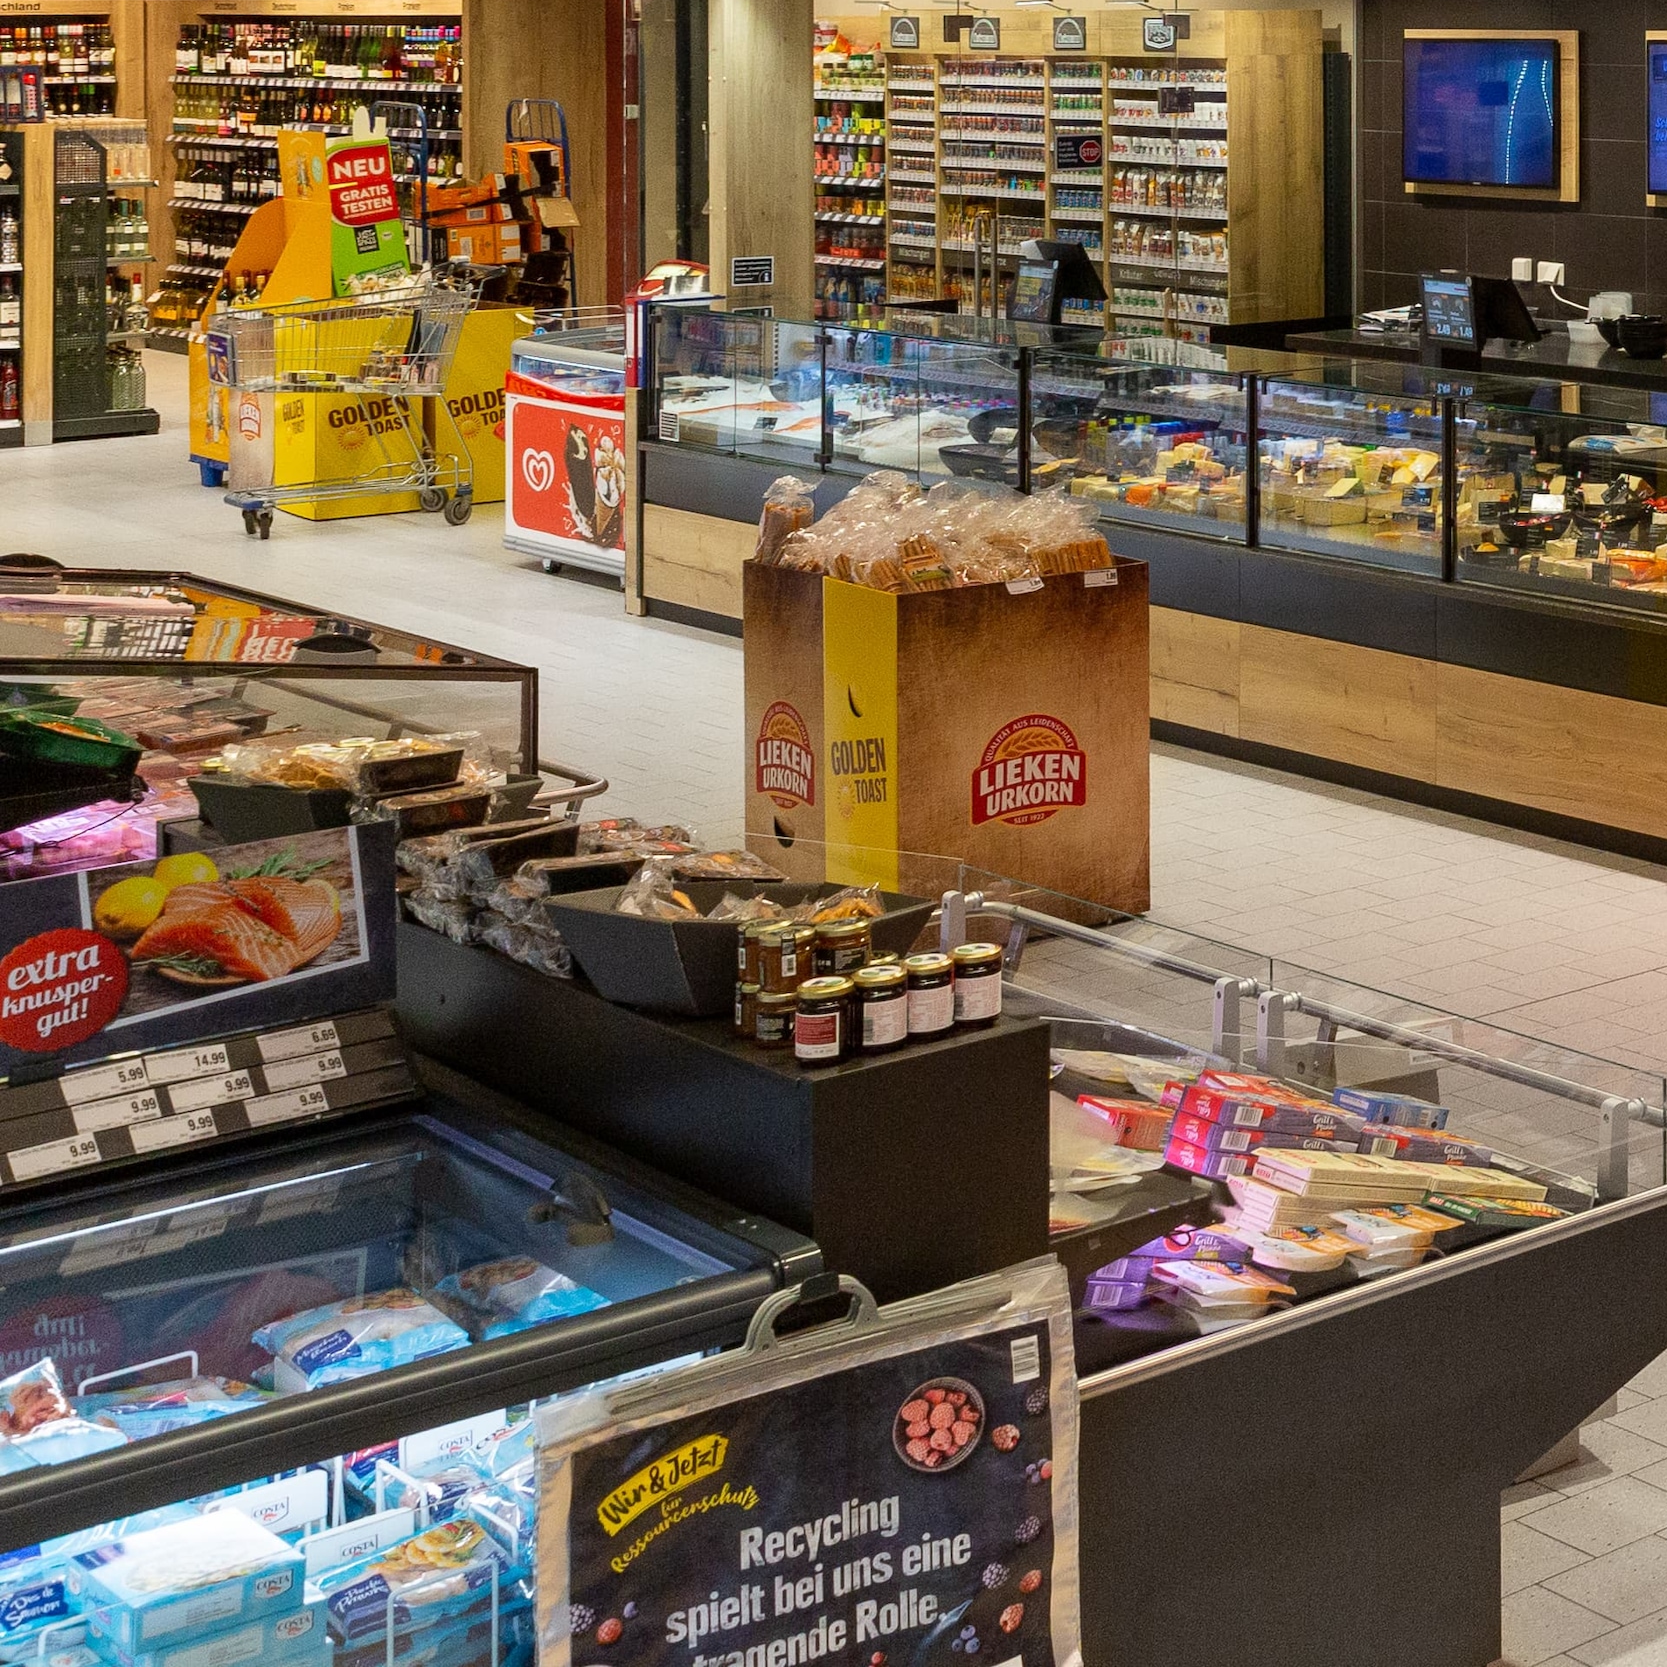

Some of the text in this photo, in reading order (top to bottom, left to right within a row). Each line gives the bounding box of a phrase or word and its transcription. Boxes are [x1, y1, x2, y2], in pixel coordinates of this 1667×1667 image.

[1082, 147, 1100, 157] STOP
[333, 156, 386, 180] NEU
[339, 183, 390, 203] GRATIS
[341, 195, 393, 215] TESTEN
[328, 394, 410, 429] GOLDEN
[447, 387, 505, 418] GOLDE
[364, 413, 412, 437] TOAST
[480, 409, 505, 426] TOA
[985, 717, 1075, 761] QUALITÄT AUS LEIDENSCHAFT
[760, 739, 812, 780] LIEKEN
[831, 737, 887, 776] GOLDEN
[763, 767, 808, 800] URKORN
[979, 753, 1081, 797] LIEKEN
[854, 777, 887, 804] TOAST
[986, 781, 1074, 817] URKORN
[1013, 815, 1029, 824] SEIT
[7, 944, 101, 991] extra
[2, 974, 114, 1019] knusper-
[37, 997, 89, 1038] gut!
[194, 1052, 227, 1068] 14.99
[317, 1056, 343, 1072] 9.99
[118, 1067, 144, 1084] 5.99
[224, 1076, 250, 1093] 9.99
[131, 1097, 157, 1113] 9.99
[299, 1091, 325, 1107] 9.99
[187, 1115, 213, 1131] 9.99
[69, 1140, 96, 1157] 9.99
[602, 1439, 723, 1525] Wir & Jetzt
[253, 1500, 287, 1519] COSTA
[661, 1495, 683, 1517] für
[610, 1482, 761, 1574] Ressourcenschutz
[739, 1494, 900, 1570] Recycling
[342, 1538, 376, 1557] COSTA
[256, 1574, 291, 1592] COSTA
[665, 1532, 972, 1650] spielt bei uns eine
[276, 1615, 312, 1632] COSTA
[856, 1589, 946, 1644] Rolle.
